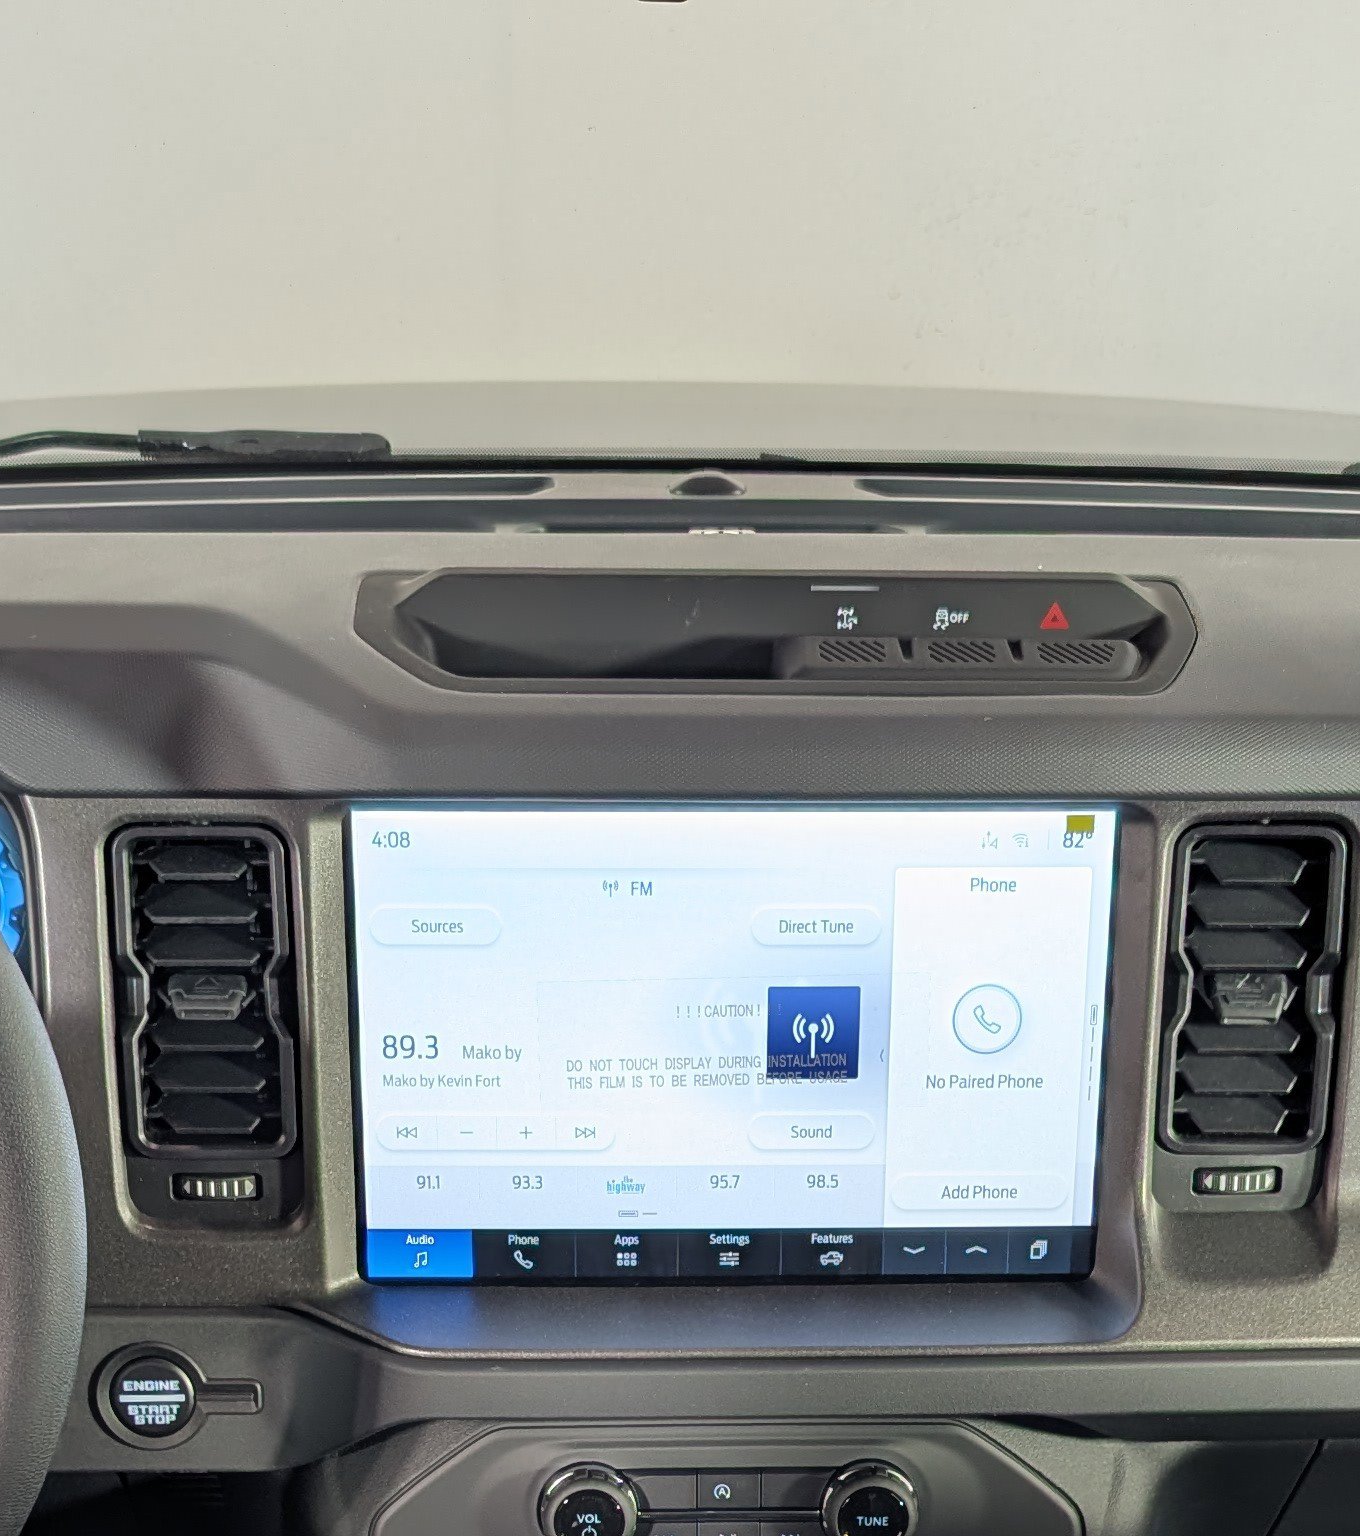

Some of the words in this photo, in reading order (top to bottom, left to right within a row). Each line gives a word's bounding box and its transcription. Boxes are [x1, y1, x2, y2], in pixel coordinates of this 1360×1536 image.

[949, 611, 970, 624] OFF
[371, 831, 411, 849] 4:08
[630, 881, 653, 896] FM
[970, 878, 1017, 893] Phone
[411, 919, 464, 935] Sources
[779, 919, 818, 934] Direct
[820, 919, 854, 934] Tune
[382, 1034, 439, 1060] 89.3
[462, 1045, 501, 1061] Mako
[505, 1045, 522, 1063] by
[566, 1059, 583, 1072] DO
[589, 1059, 612, 1072] NOT
[618, 1058, 658, 1071] TOUCH
[664, 1057, 712, 1070] DISPLAY
[718, 1055, 761, 1069] DURING
[767, 1053, 848, 1067] INSTALLATION
[382, 1074, 418, 1088] Mako
[420, 1074, 435, 1090] by
[437, 1074, 473, 1088] Kevin
[475, 1074, 502, 1088] Fort
[567, 1076, 593, 1089] THIS
[599, 1076, 625, 1089] FILM
[632, 1075, 643, 1088] IS
[649, 1075, 665, 1088] TO
[671, 1075, 688, 1088] BE
[693, 1073, 750, 1087] REMOVED
[757, 1072, 802, 1085] BEFORE
[808, 1071, 849, 1084] USAGE
[925, 1074, 946, 1089] No
[948, 1073, 994, 1089] Paired
[996, 1073, 1044, 1089] Phone
[790, 1124, 833, 1140] Sound
[416, 1175, 441, 1190] 91.1
[512, 1175, 543, 1190] 93.3
[623, 1175, 634, 1183] the
[709, 1174, 740, 1189] 95.7
[806, 1174, 839, 1189] 98.5
[606, 1179, 646, 1195] highway
[941, 1185, 971, 1200] Add
[973, 1185, 1018, 1200] Phone
[405, 1233, 435, 1246] Audio
[507, 1234, 540, 1246] Phone
[614, 1234, 640, 1247] Apps
[709, 1233, 750, 1247] Settings
[810, 1232, 854, 1245] Features
[122, 1379, 181, 1392] ENGINE
[127, 1404, 181, 1416] START
[134, 1414, 177, 1425] STOP
[576, 1513, 602, 1524] VOL
[856, 1515, 890, 1527] TUNE
